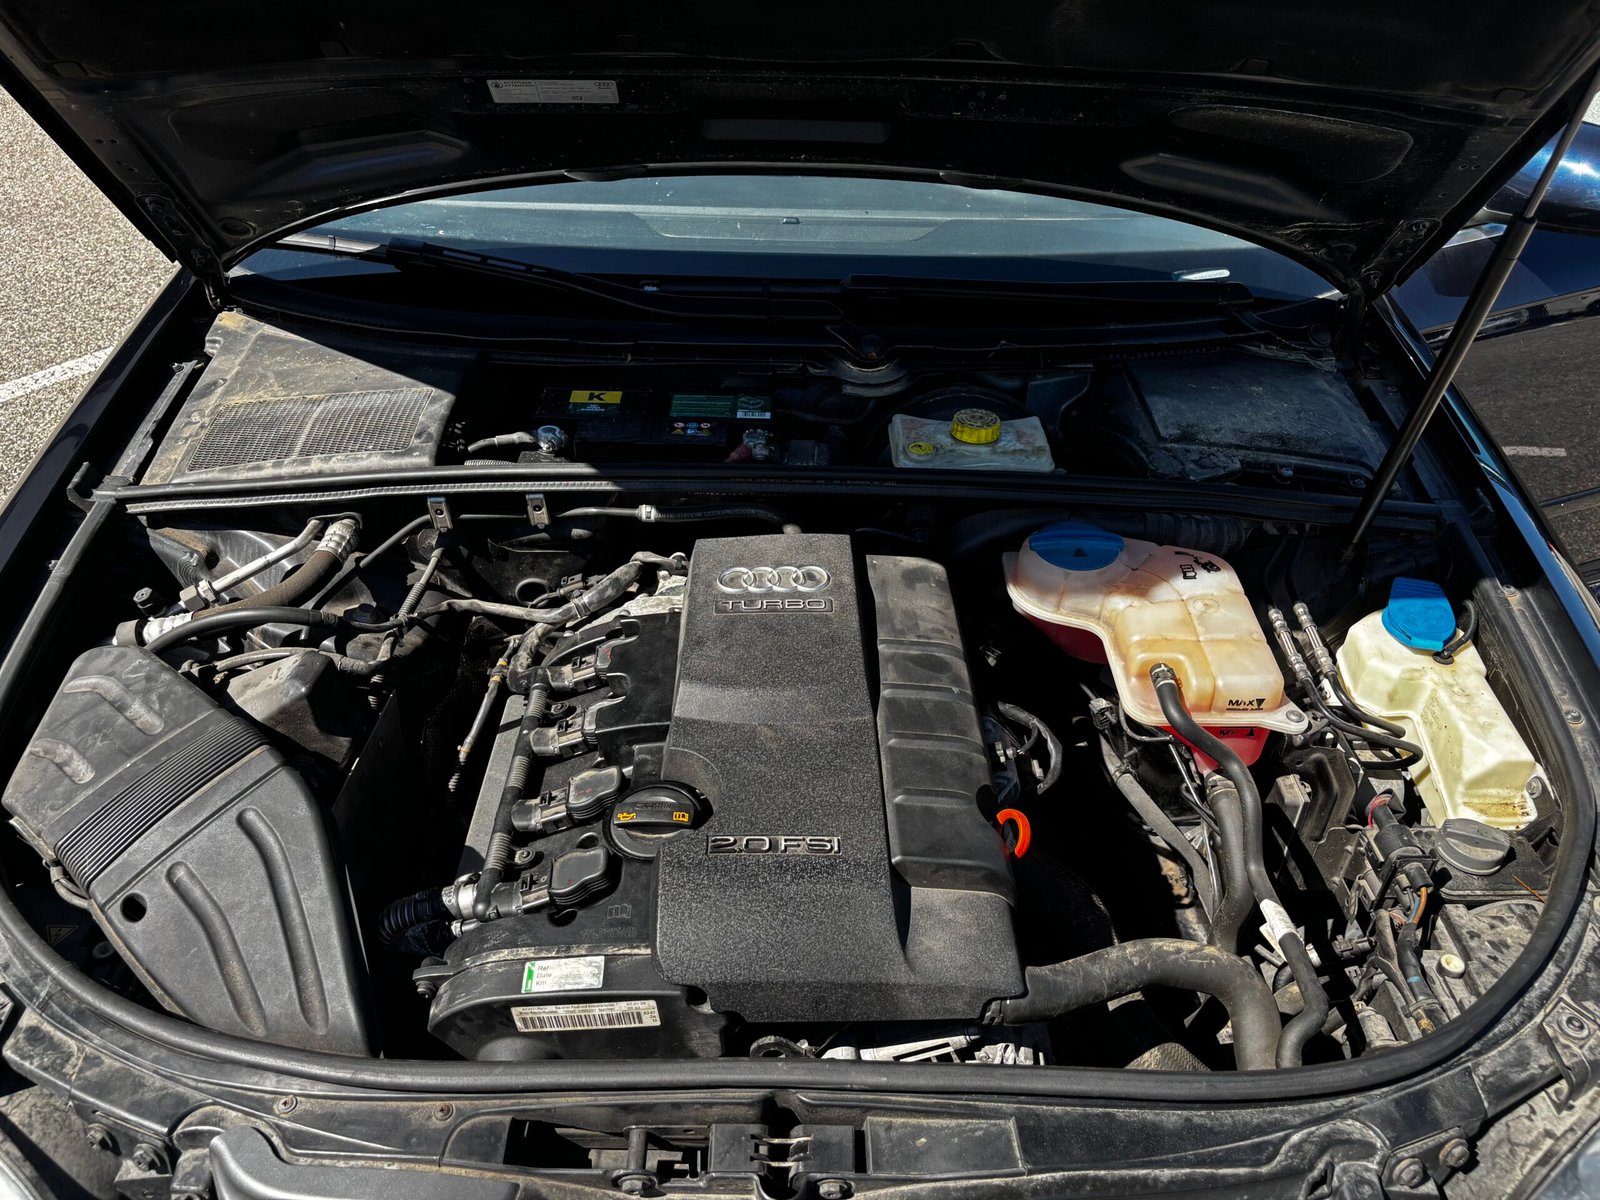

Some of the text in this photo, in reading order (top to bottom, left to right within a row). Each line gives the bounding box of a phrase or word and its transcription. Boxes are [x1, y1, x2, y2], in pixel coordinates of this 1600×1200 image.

[588, 392, 607, 401] K
[721, 599, 826, 610] TURBO
[710, 836, 841, 853] 2.0 FSI
